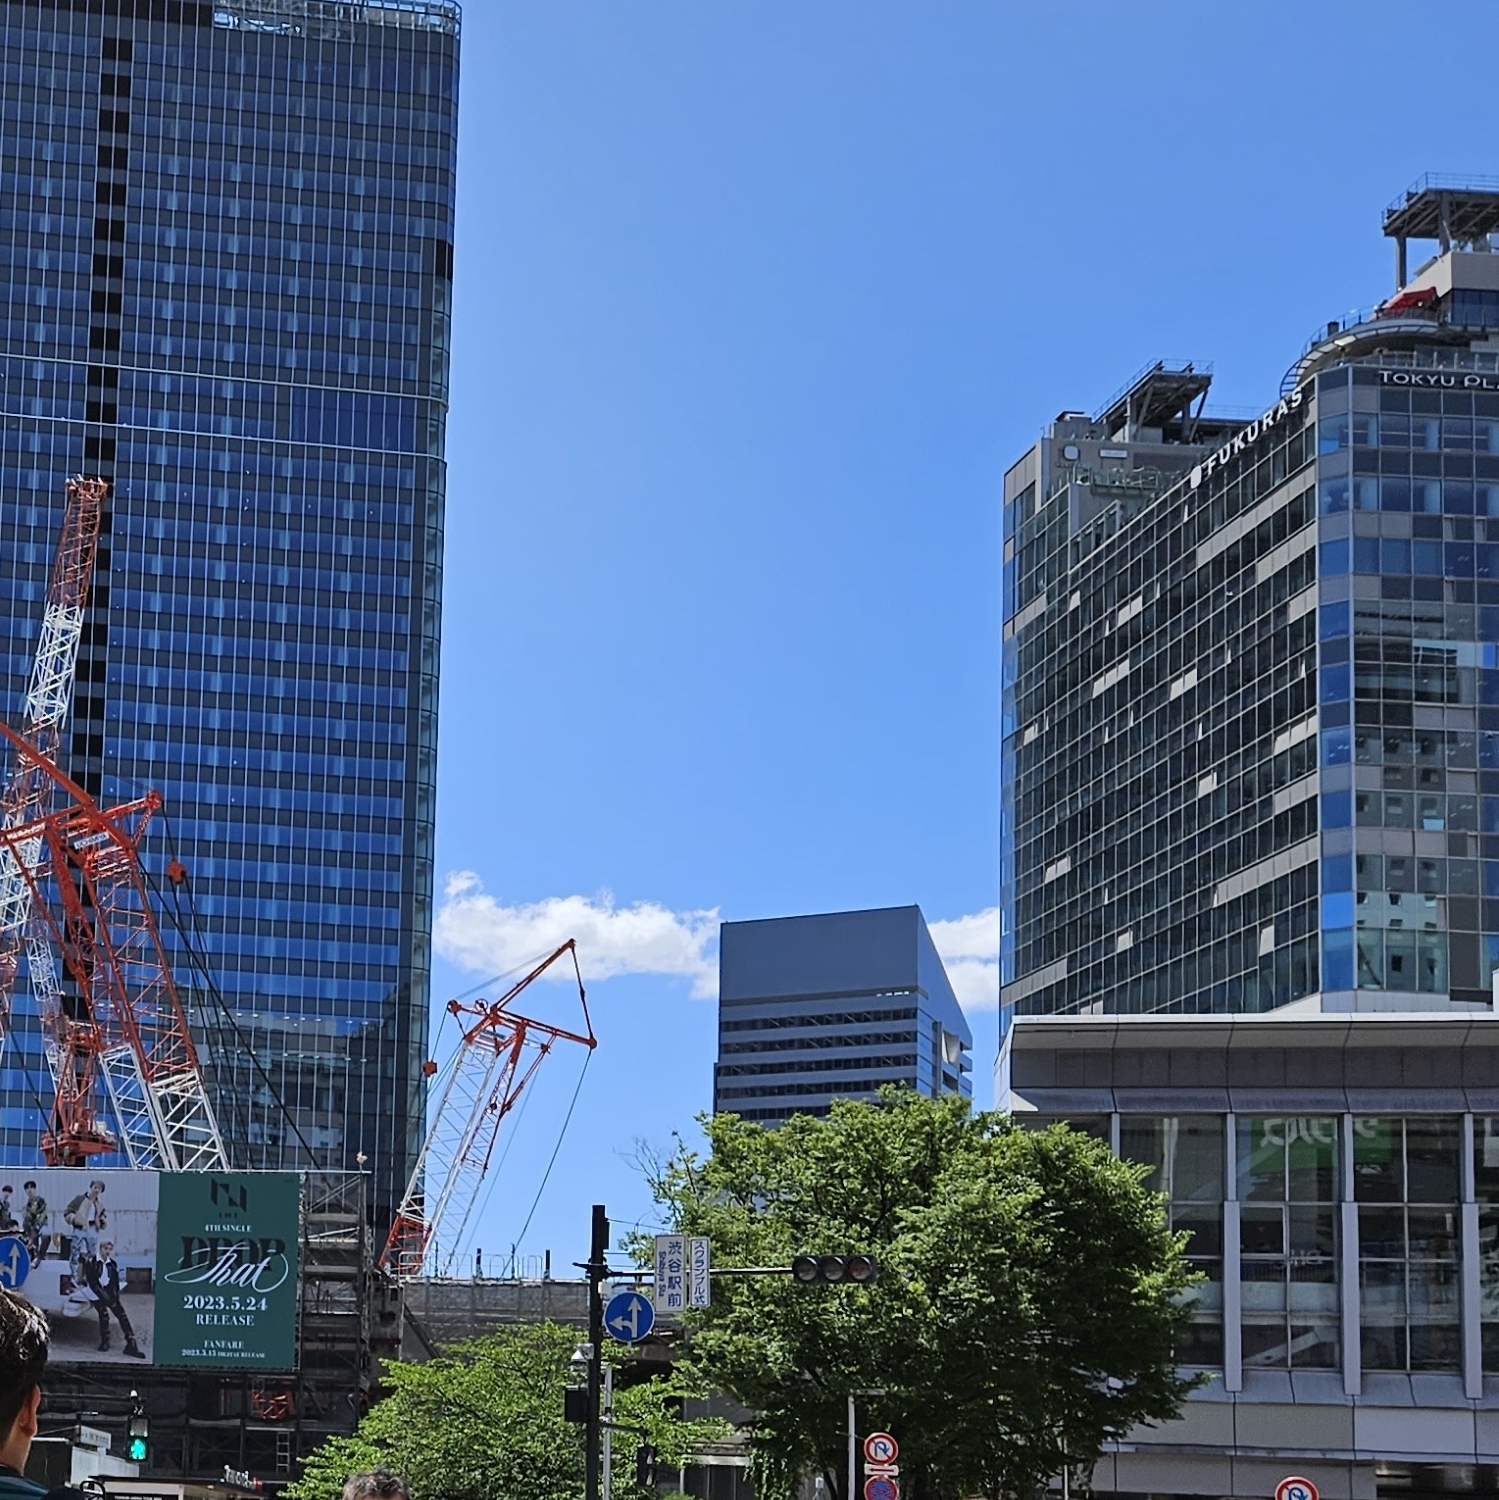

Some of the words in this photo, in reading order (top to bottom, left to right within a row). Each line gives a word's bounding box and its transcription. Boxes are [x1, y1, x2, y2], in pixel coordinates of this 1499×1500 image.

[1379, 370, 1455, 387] TOKYU
[1464, 374, 1499, 390] PL
[1206, 386, 1304, 476] FUKURAS
[222, 1224, 253, 1233] SINGLE
[164, 1242, 289, 1293] That
[667, 1240, 682, 1307] 渋谷駅前
[694, 1241, 706, 1304] スクランブル式
[183, 1295, 268, 1311] 2023.5.24
[196, 1314, 255, 1326] RELEASE
[204, 1339, 245, 1350] FANFARE
